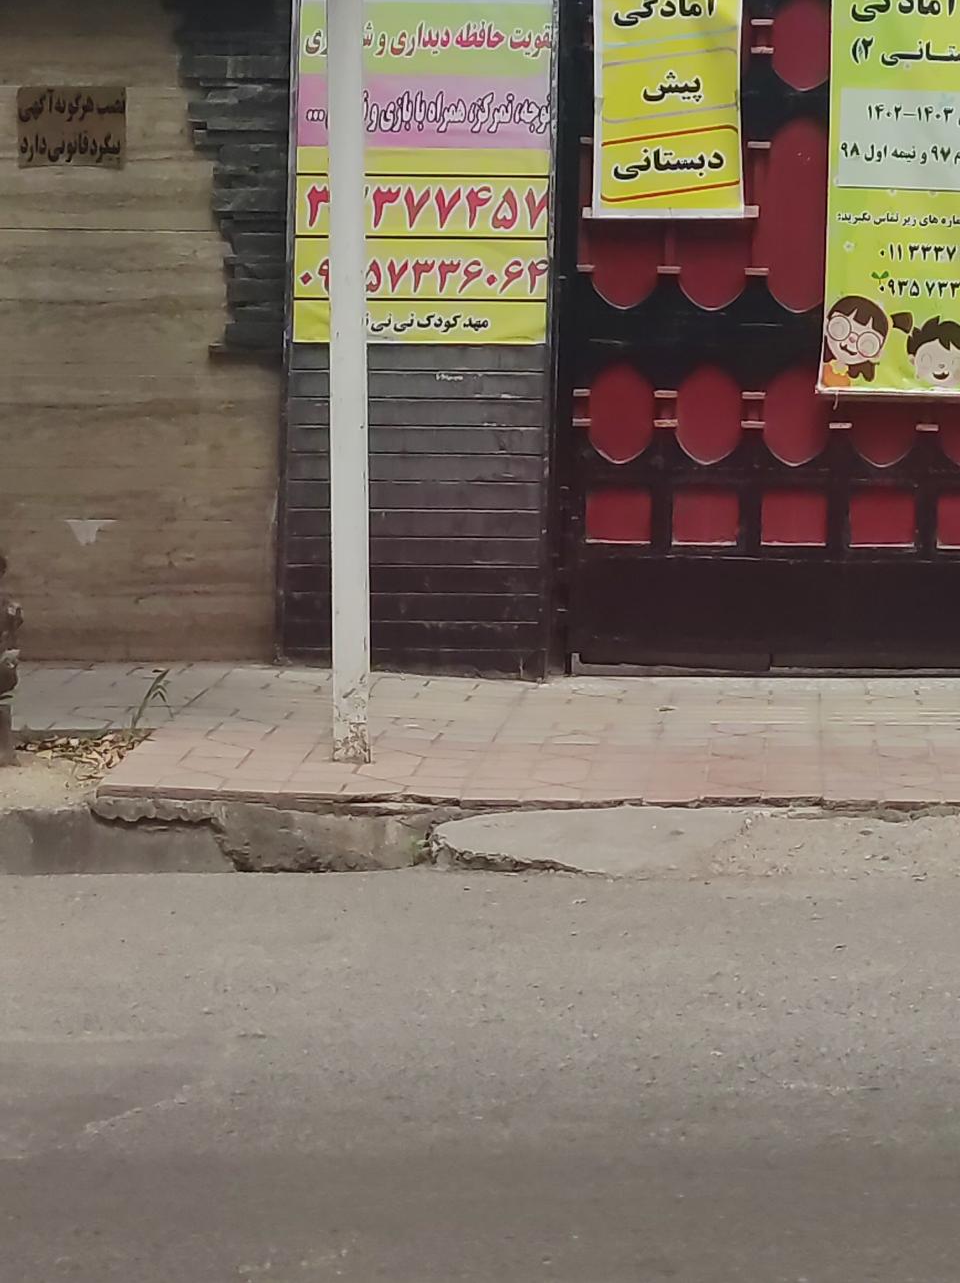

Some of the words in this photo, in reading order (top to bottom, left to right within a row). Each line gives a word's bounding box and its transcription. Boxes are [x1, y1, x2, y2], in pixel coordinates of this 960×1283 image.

[375, 32, 387, 56] و
[391, 21, 452, 57] دیداری
[455, 21, 505, 49] حافظه
[510, 24, 553, 58] قویت
[642, 71, 702, 103] پیش
[366, 103, 379, 133] و
[379, 90, 413, 133] بازی
[414, 90, 426, 132] با
[427, 90, 467, 134] همراه
[840, 141, 860, 158] ۹۸
[864, 144, 888, 162] اول
[891, 145, 917, 163] نیمه
[920, 150, 928, 164] و
[930, 145, 951, 162] ۹۷
[613, 147, 725, 181] دبستانی
[306, 185, 549, 230] ۳۳۷۷۴۵۷
[873, 211, 899, 225] تماس
[902, 215, 917, 227] زیر
[919, 214, 939, 227] های
[879, 243, 902, 261] ۰۱۱
[908, 244, 956, 262] ۳۳۳۷
[299, 257, 549, 295] ۰۹۵۷۳۳۶۰۶۴
[925, 278, 960, 298] ۷۳۳
[370, 313, 392, 332] نی
[393, 313, 415, 332] نی
[417, 313, 461, 333] کودک
[463, 317, 489, 332] مهد
